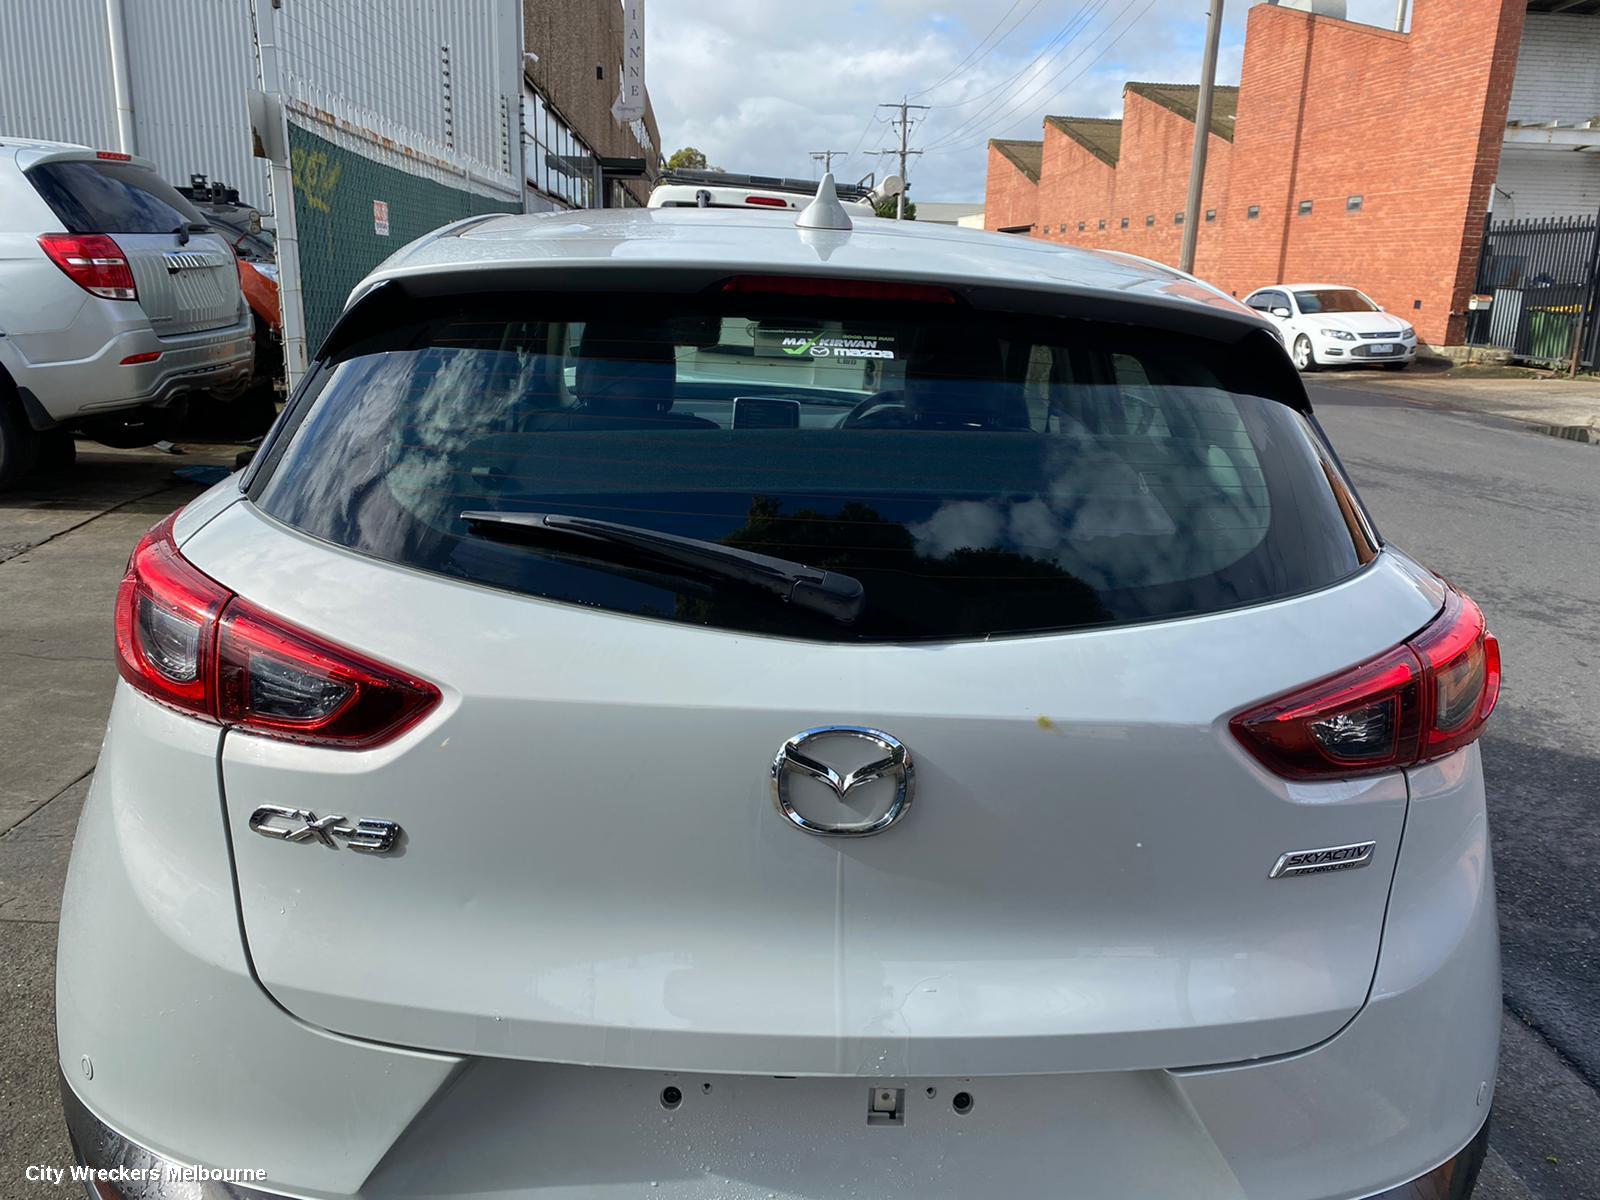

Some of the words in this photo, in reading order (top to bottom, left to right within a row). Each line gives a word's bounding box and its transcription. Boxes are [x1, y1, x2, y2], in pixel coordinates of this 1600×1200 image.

[819, 338, 877, 349] KIRWAN
[833, 348, 895, 359] mazda
[249, 804, 400, 853] CX-3
[1288, 845, 1368, 866] SKYACTIV
[1294, 861, 1357, 876] TECHNOLOGY
